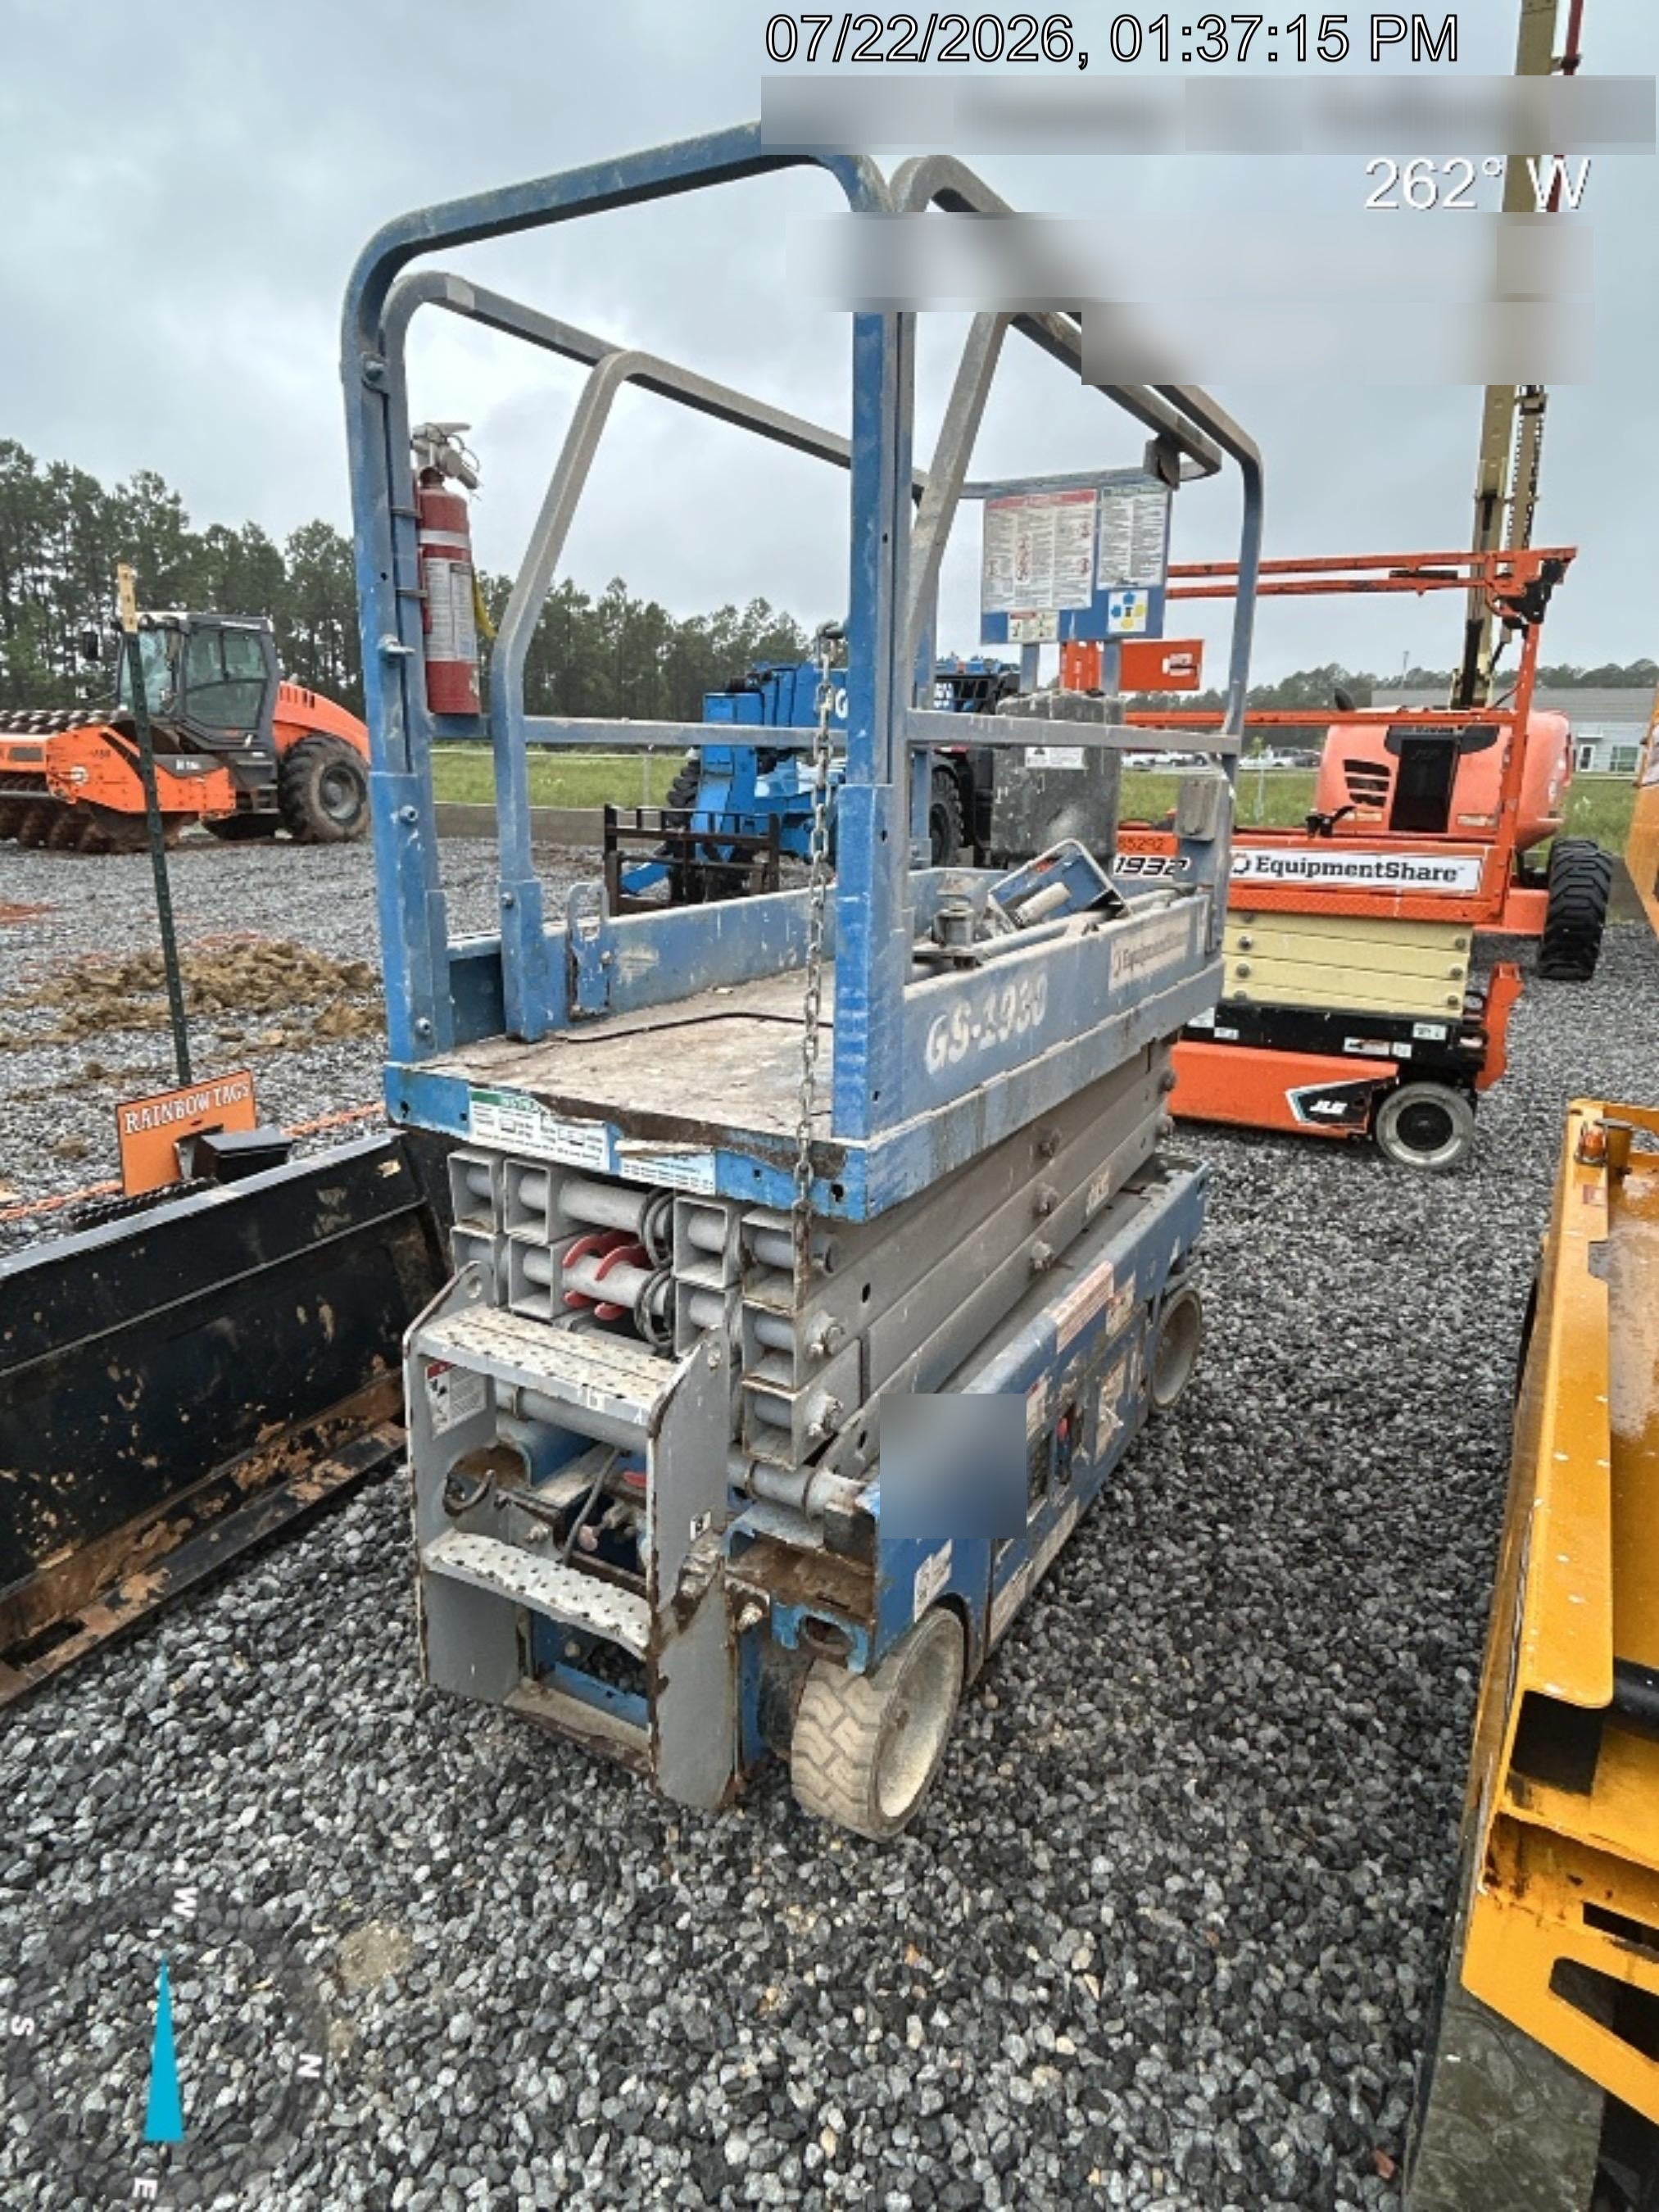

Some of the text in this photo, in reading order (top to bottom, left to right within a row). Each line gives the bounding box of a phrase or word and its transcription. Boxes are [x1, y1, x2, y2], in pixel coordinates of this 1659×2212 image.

[1255, 855, 1457, 882] EquipmentShare
[125, 1082, 249, 1134] RAINBOW TAGS
